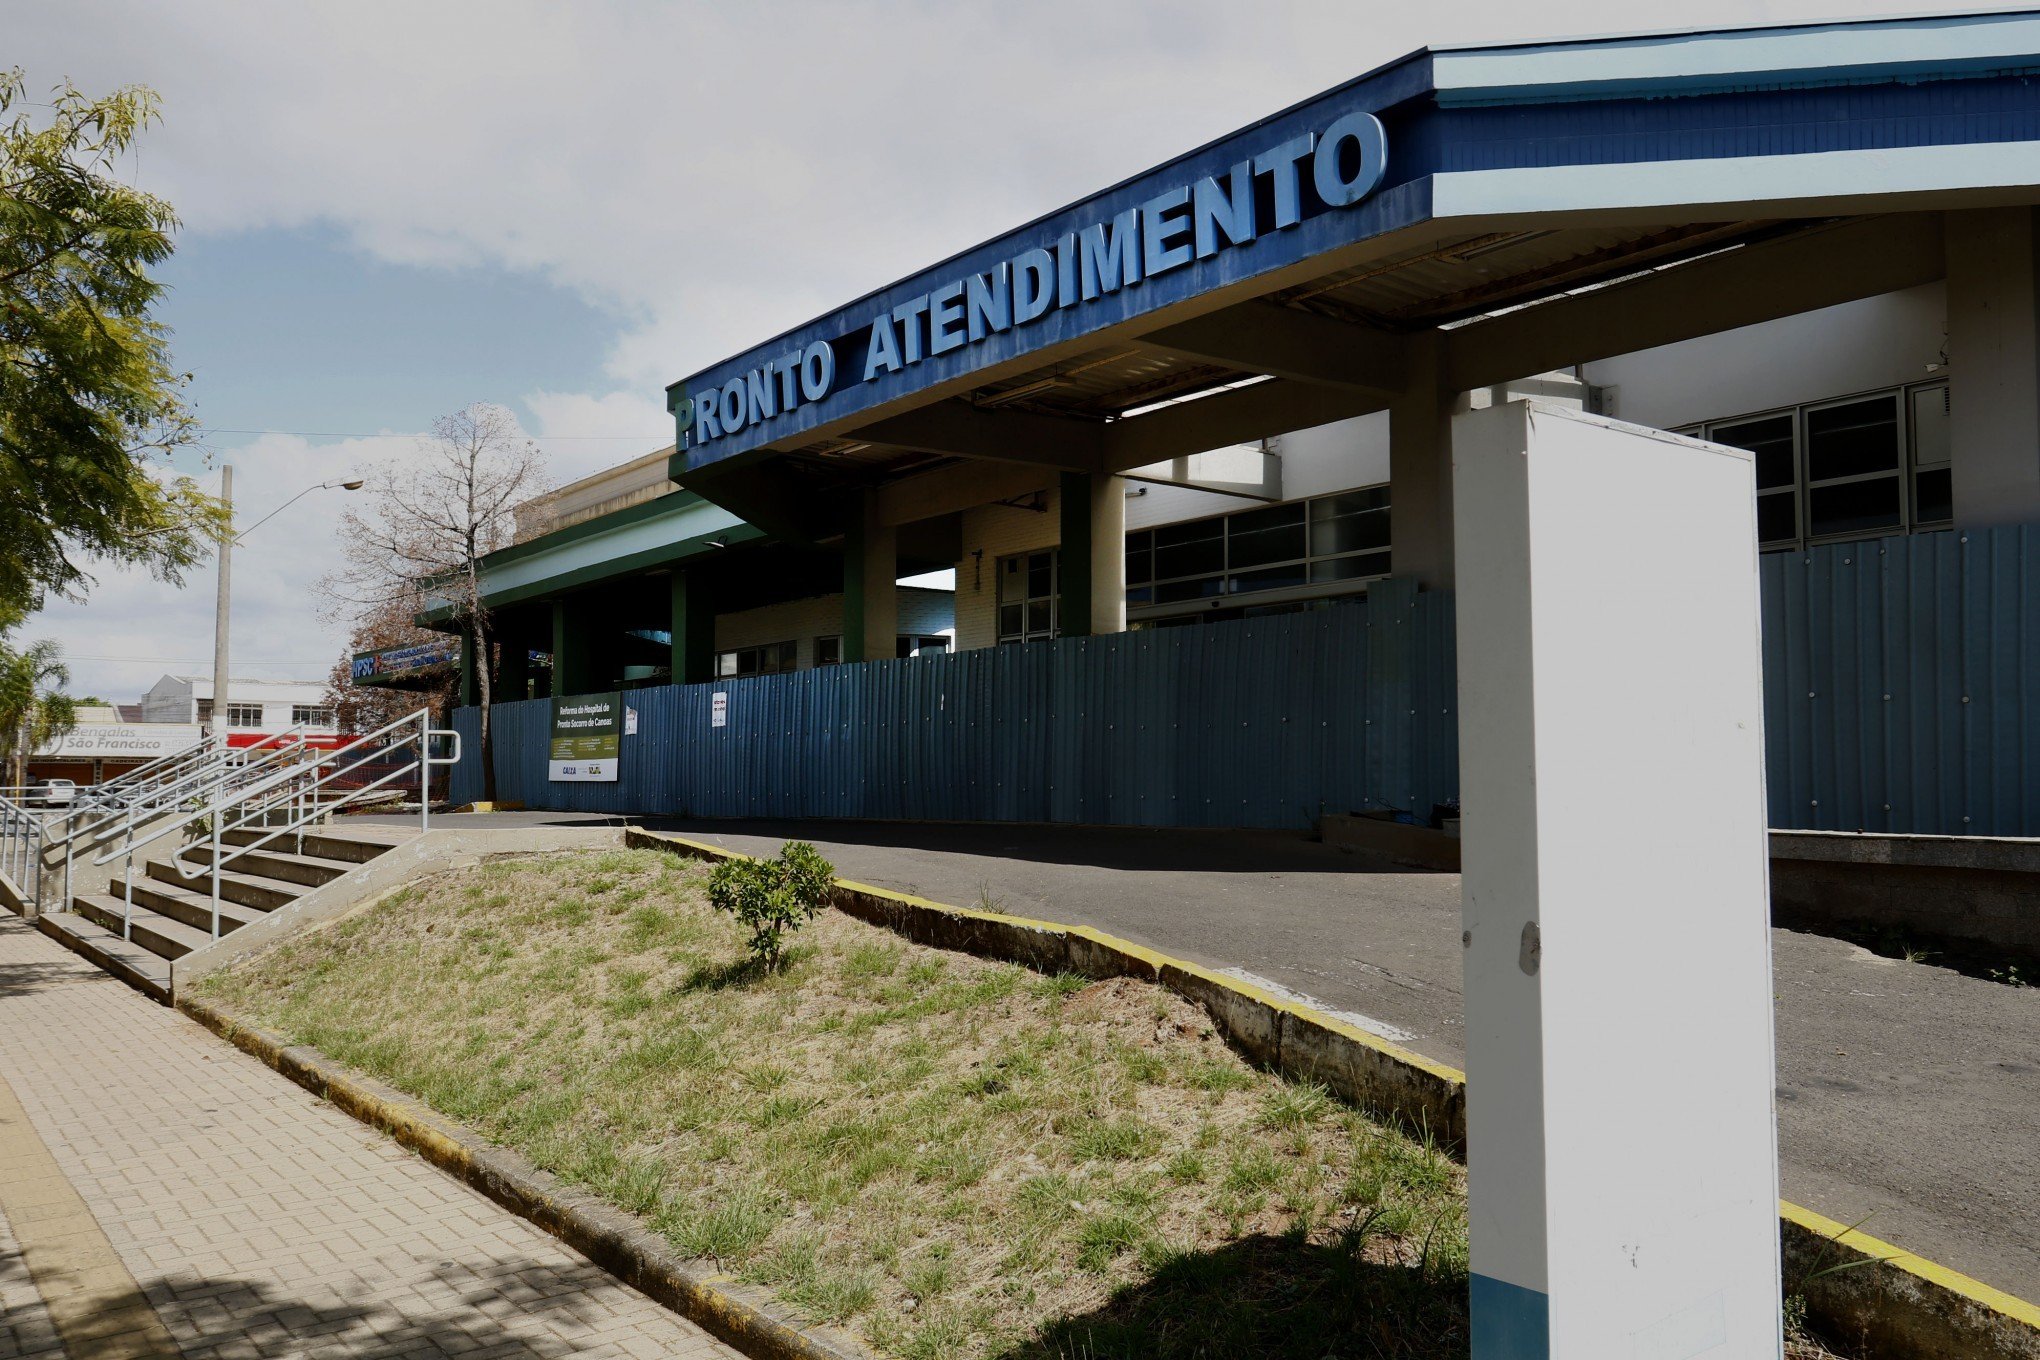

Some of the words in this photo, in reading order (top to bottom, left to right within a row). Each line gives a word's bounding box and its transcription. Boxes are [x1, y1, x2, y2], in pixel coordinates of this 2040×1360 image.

[674, 339, 836, 453] PRONTO
[862, 110, 1390, 382] ATENDIMENTO
[352, 657, 374, 678] HPSC
[559, 706, 577, 715] Reforma
[578, 706, 583, 714] do
[584, 703, 603, 715] Hospital
[603, 703, 610, 712] de
[557, 719, 570, 728] Pronto
[571, 719, 587, 728] Socorro
[588, 718, 594, 726] de
[595, 717, 612, 726] Canoas
[69, 726, 136, 740] Bengalas
[67, 737, 94, 748] São
[97, 737, 161, 749] Francisco
[563, 766, 577, 775] CAIXA
